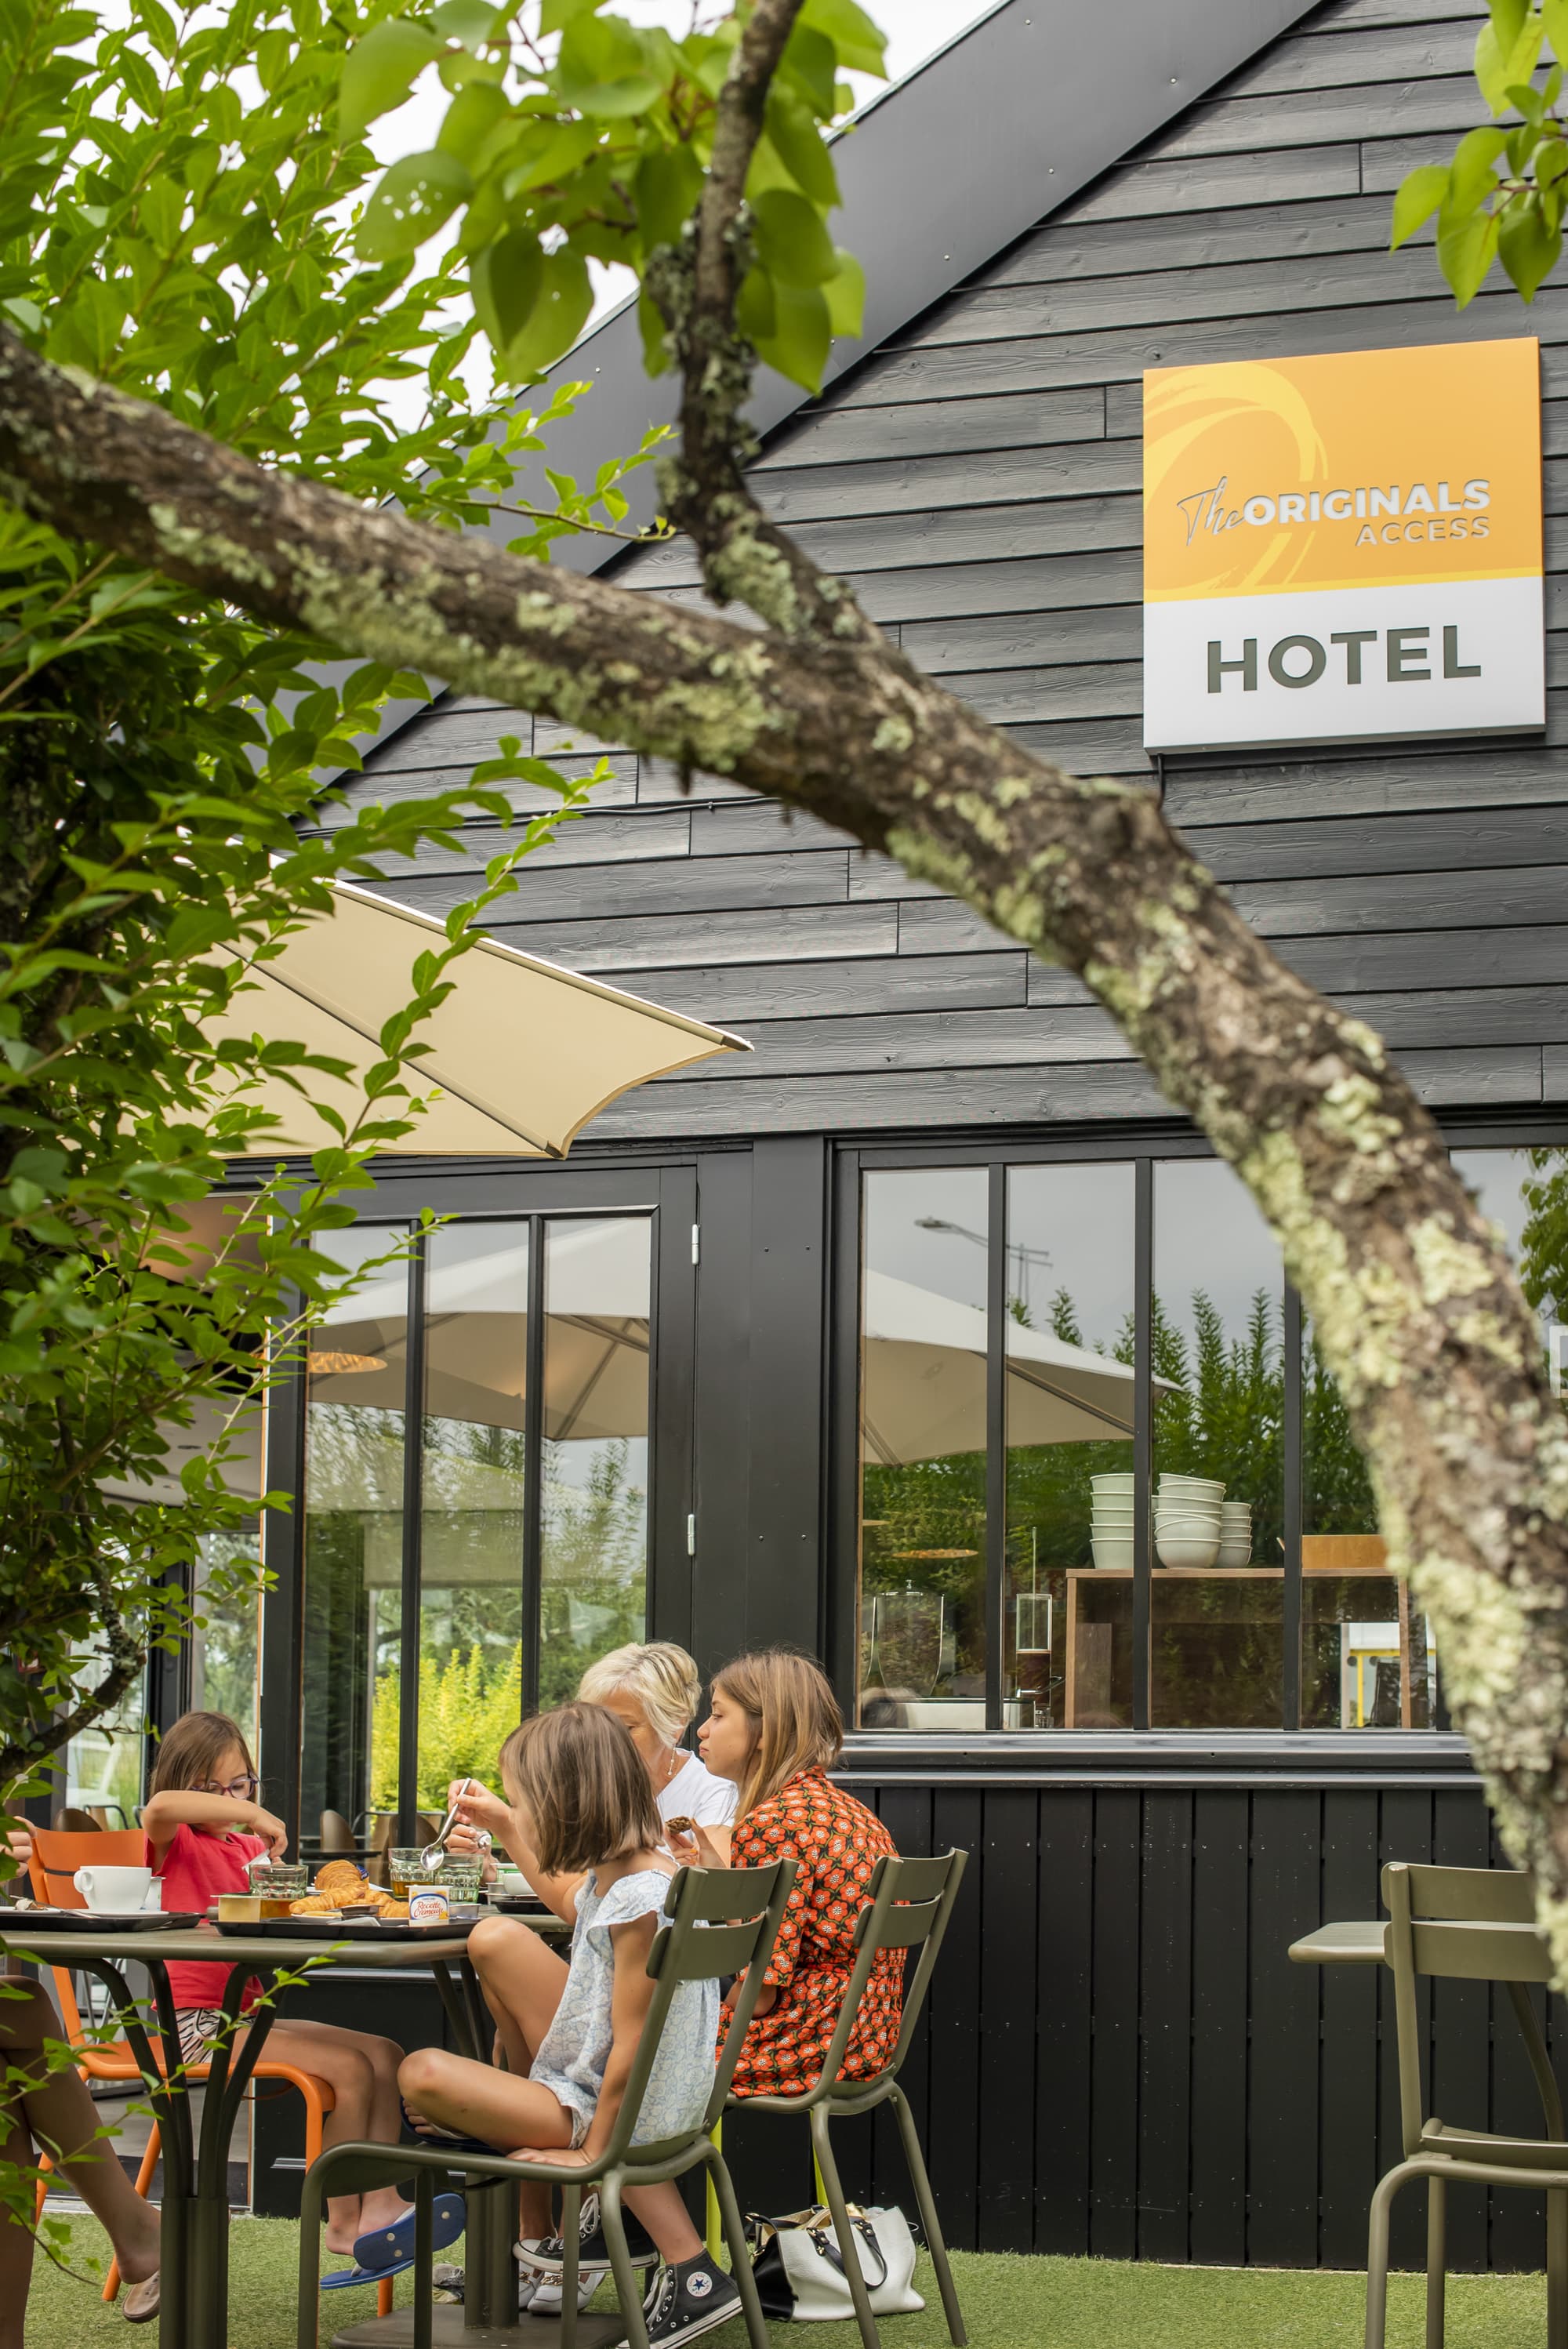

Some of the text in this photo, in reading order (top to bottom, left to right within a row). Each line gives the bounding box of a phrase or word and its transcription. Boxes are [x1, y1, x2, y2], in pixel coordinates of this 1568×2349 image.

[1176, 475, 1490, 546] The ORIGINALS
[1355, 516, 1490, 546] ACCESS
[1207, 625, 1482, 694] HOTEL
